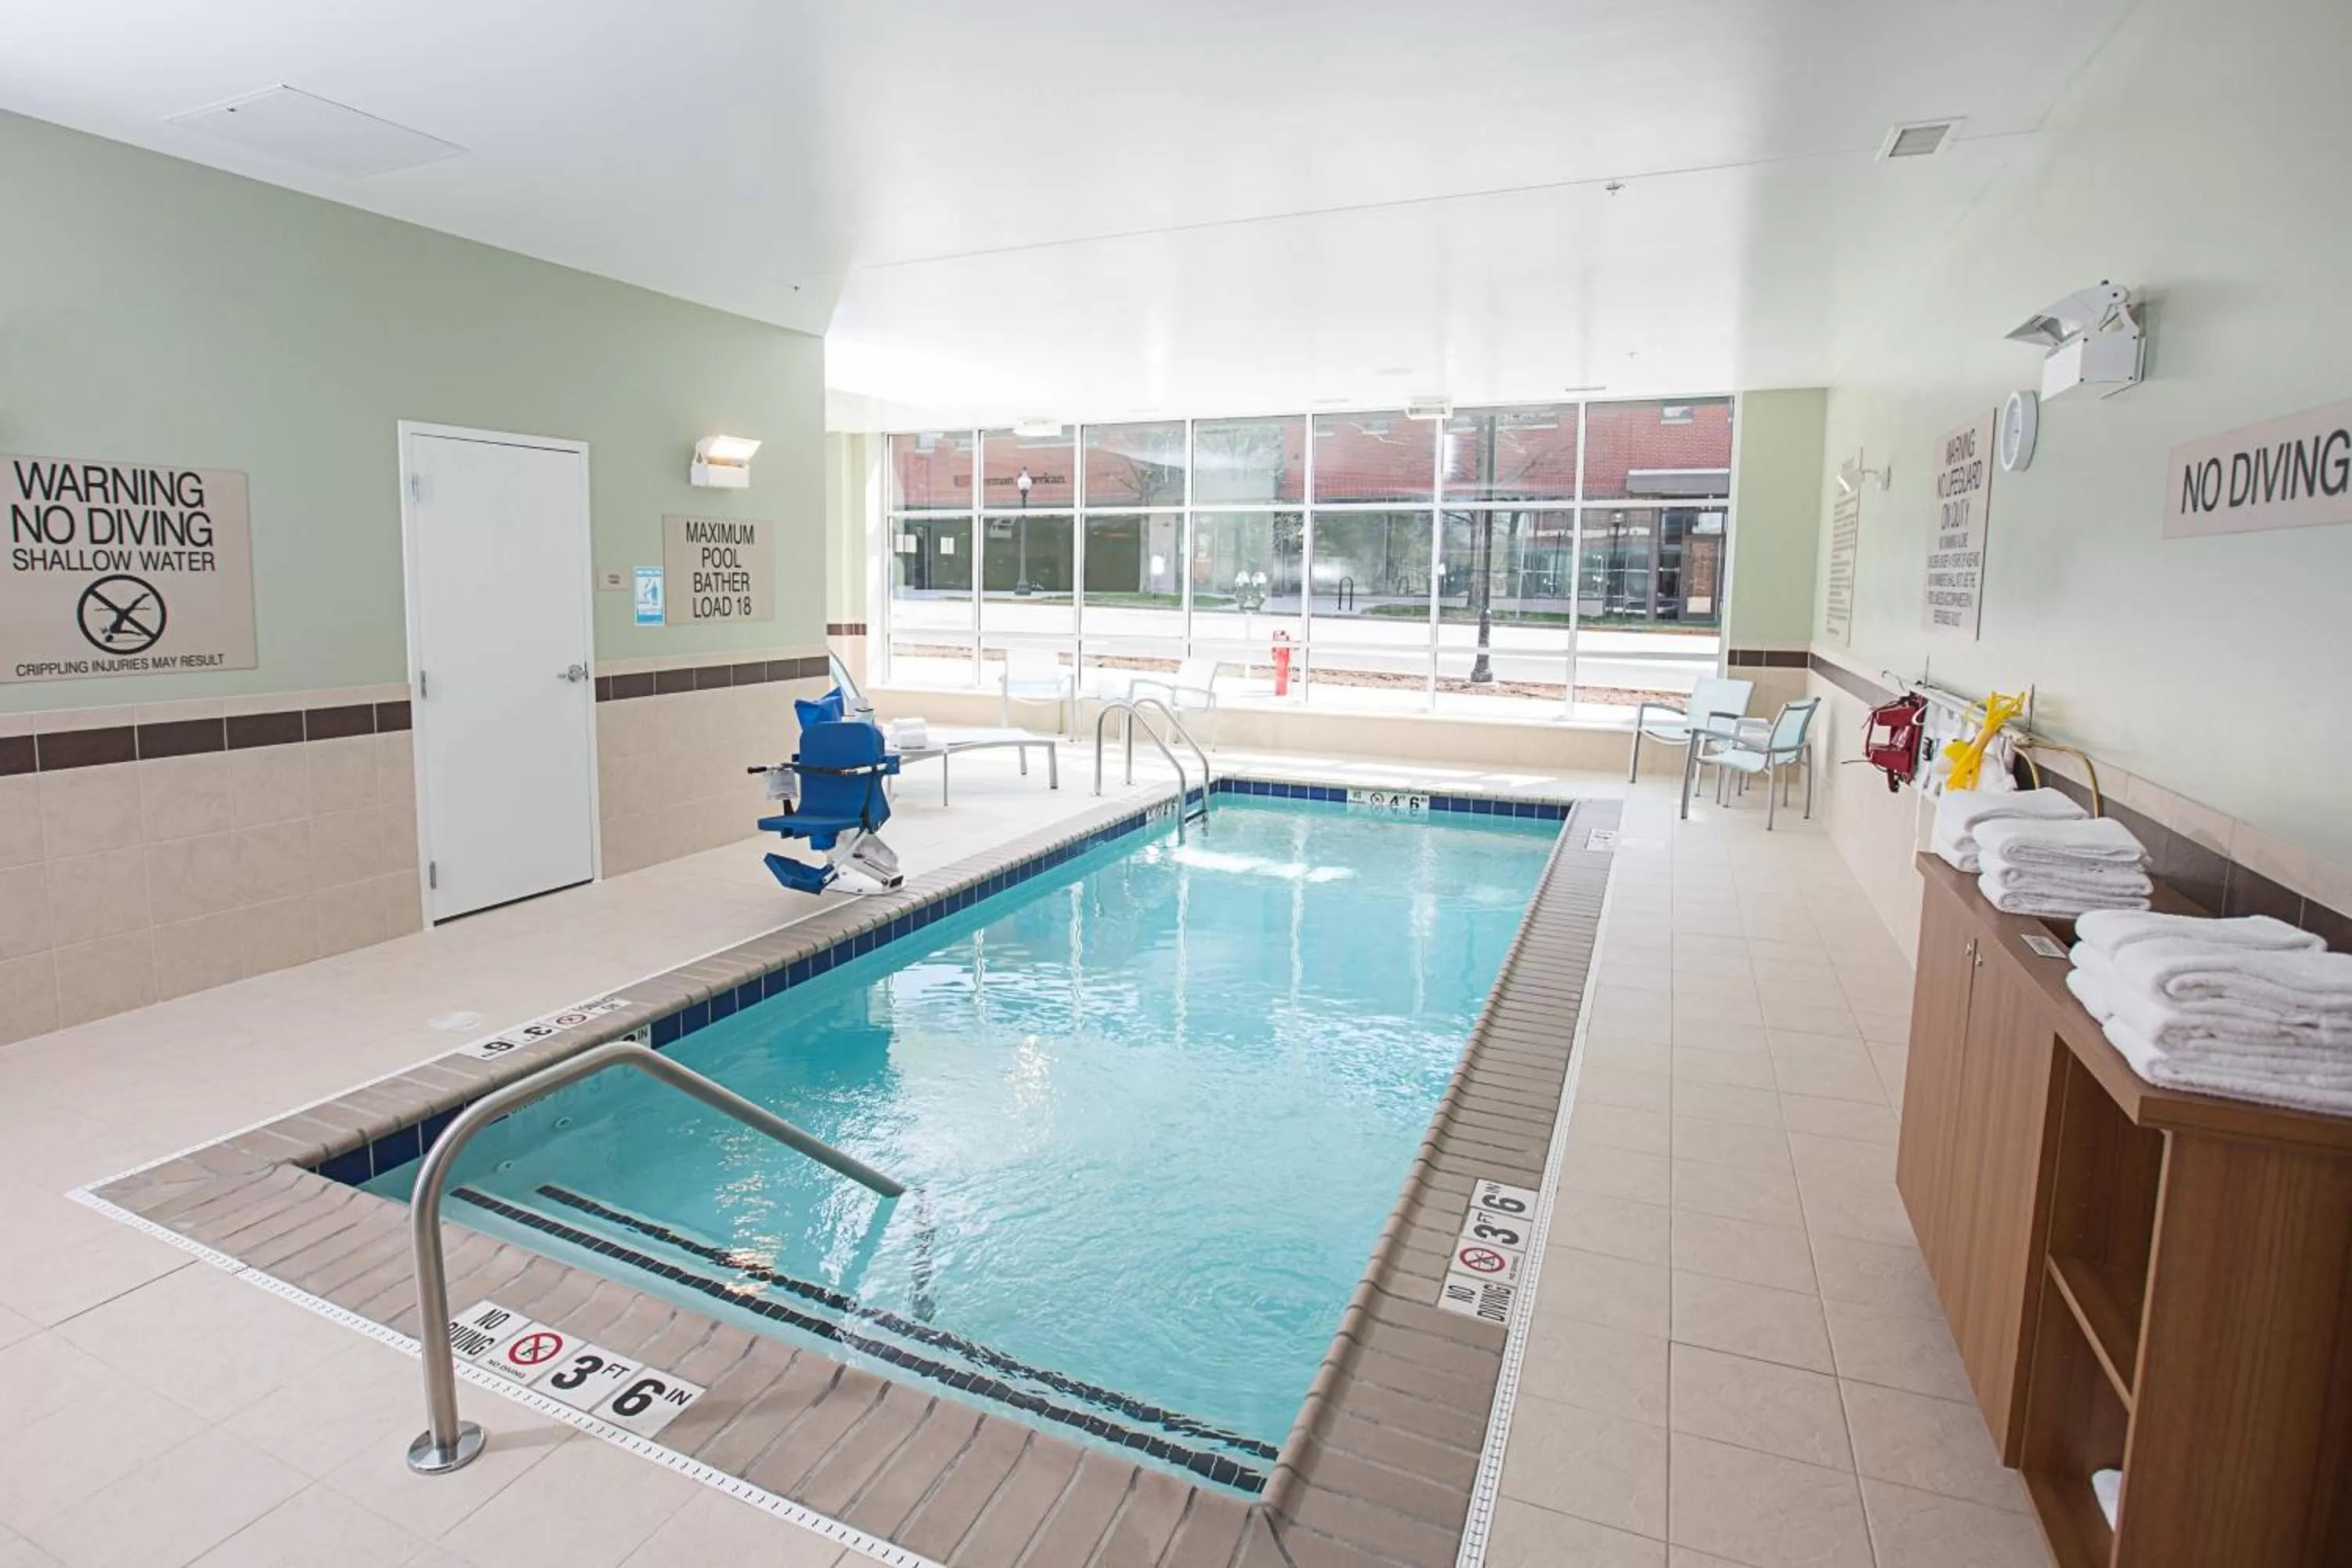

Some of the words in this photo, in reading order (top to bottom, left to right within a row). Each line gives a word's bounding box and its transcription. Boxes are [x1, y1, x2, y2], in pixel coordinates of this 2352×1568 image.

[2182, 457, 2222, 514] NO
[2229, 429, 2351, 507] DIVING
[13, 460, 204, 508] WARNING
[11, 504, 75, 544] NO
[88, 507, 213, 547] DIVING
[686, 521, 754, 544] MAXIMUM
[13, 549, 132, 572] SHALLOW
[139, 551, 216, 572] WATER
[702, 547, 742, 568] POOL
[693, 572, 750, 593] BATHER
[692, 597, 733, 618] LOAD
[737, 596, 752, 615] 18
[16, 660, 89, 677] CRIPPLING
[92, 658, 149, 673] INJURIES
[151, 655, 179, 669] MAY
[180, 653, 224, 666] RESULT
[1390, 795, 1399, 806] 4
[524, 1026, 552, 1036] 3
[638, 1029, 648, 1040] IN
[483, 1041, 514, 1051] 6
[1485, 1183, 1501, 1194] IN
[1483, 1194, 1526, 1213] 6
[1477, 1212, 1494, 1225] FT
[1474, 1225, 1519, 1244] 3
[1446, 1284, 1475, 1304] NO
[1477, 1283, 1512, 1323] DIVING
[474, 1308, 510, 1330] NO
[551, 1356, 604, 1389] 3
[602, 1363, 631, 1379] FT
[612, 1378, 666, 1416] 6
[665, 1388, 692, 1406] IN
